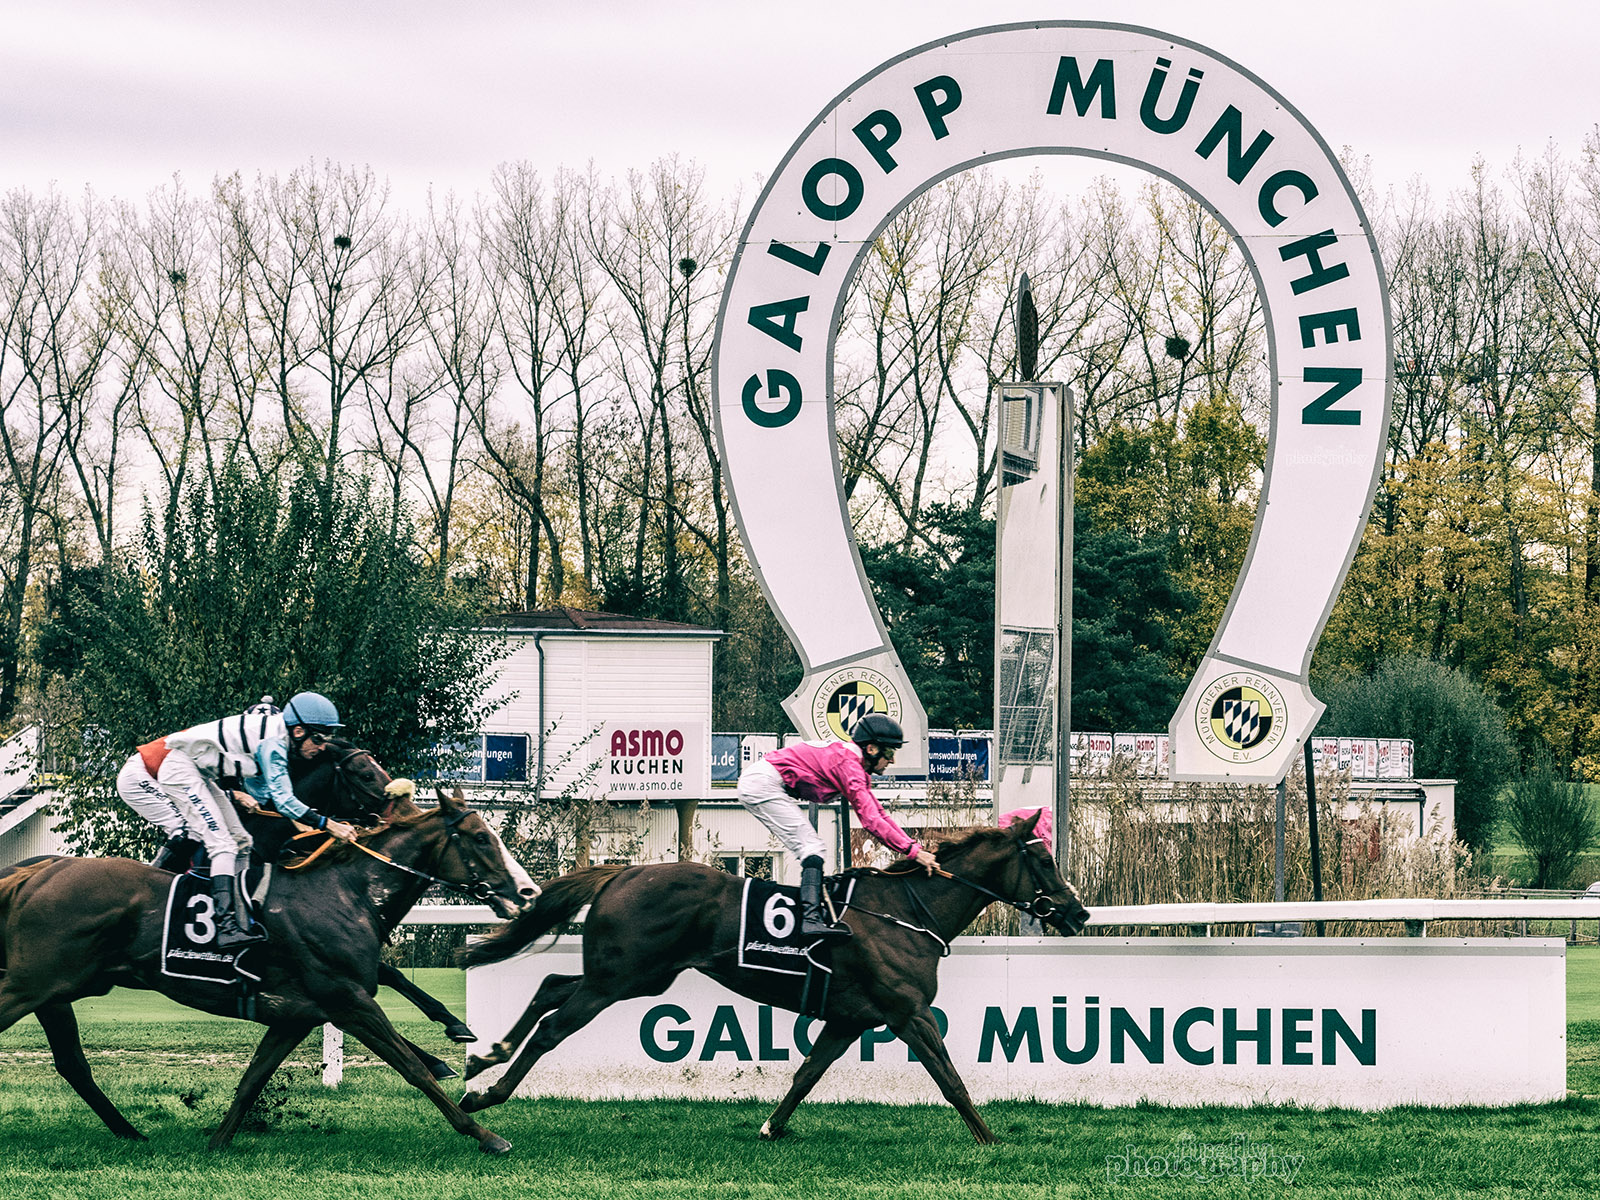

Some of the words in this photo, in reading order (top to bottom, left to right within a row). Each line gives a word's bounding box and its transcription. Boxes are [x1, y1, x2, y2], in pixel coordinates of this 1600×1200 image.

[741, 75, 963, 429] GALOPP
[1046, 55, 1362, 426] MÜNCHEN
[860, 671, 899, 718] RENNVER
[1244, 676, 1284, 745] RENNVEREIN
[610, 729, 684, 757] ASMO
[610, 758, 684, 775] KÜCHEN
[1232, 751, 1252, 761] E.V.
[609, 778, 683, 791] www.asmo.de
[184, 893, 217, 945] 3
[763, 892, 797, 939] 6
[977, 995, 1377, 1066] MÜNCHEN
